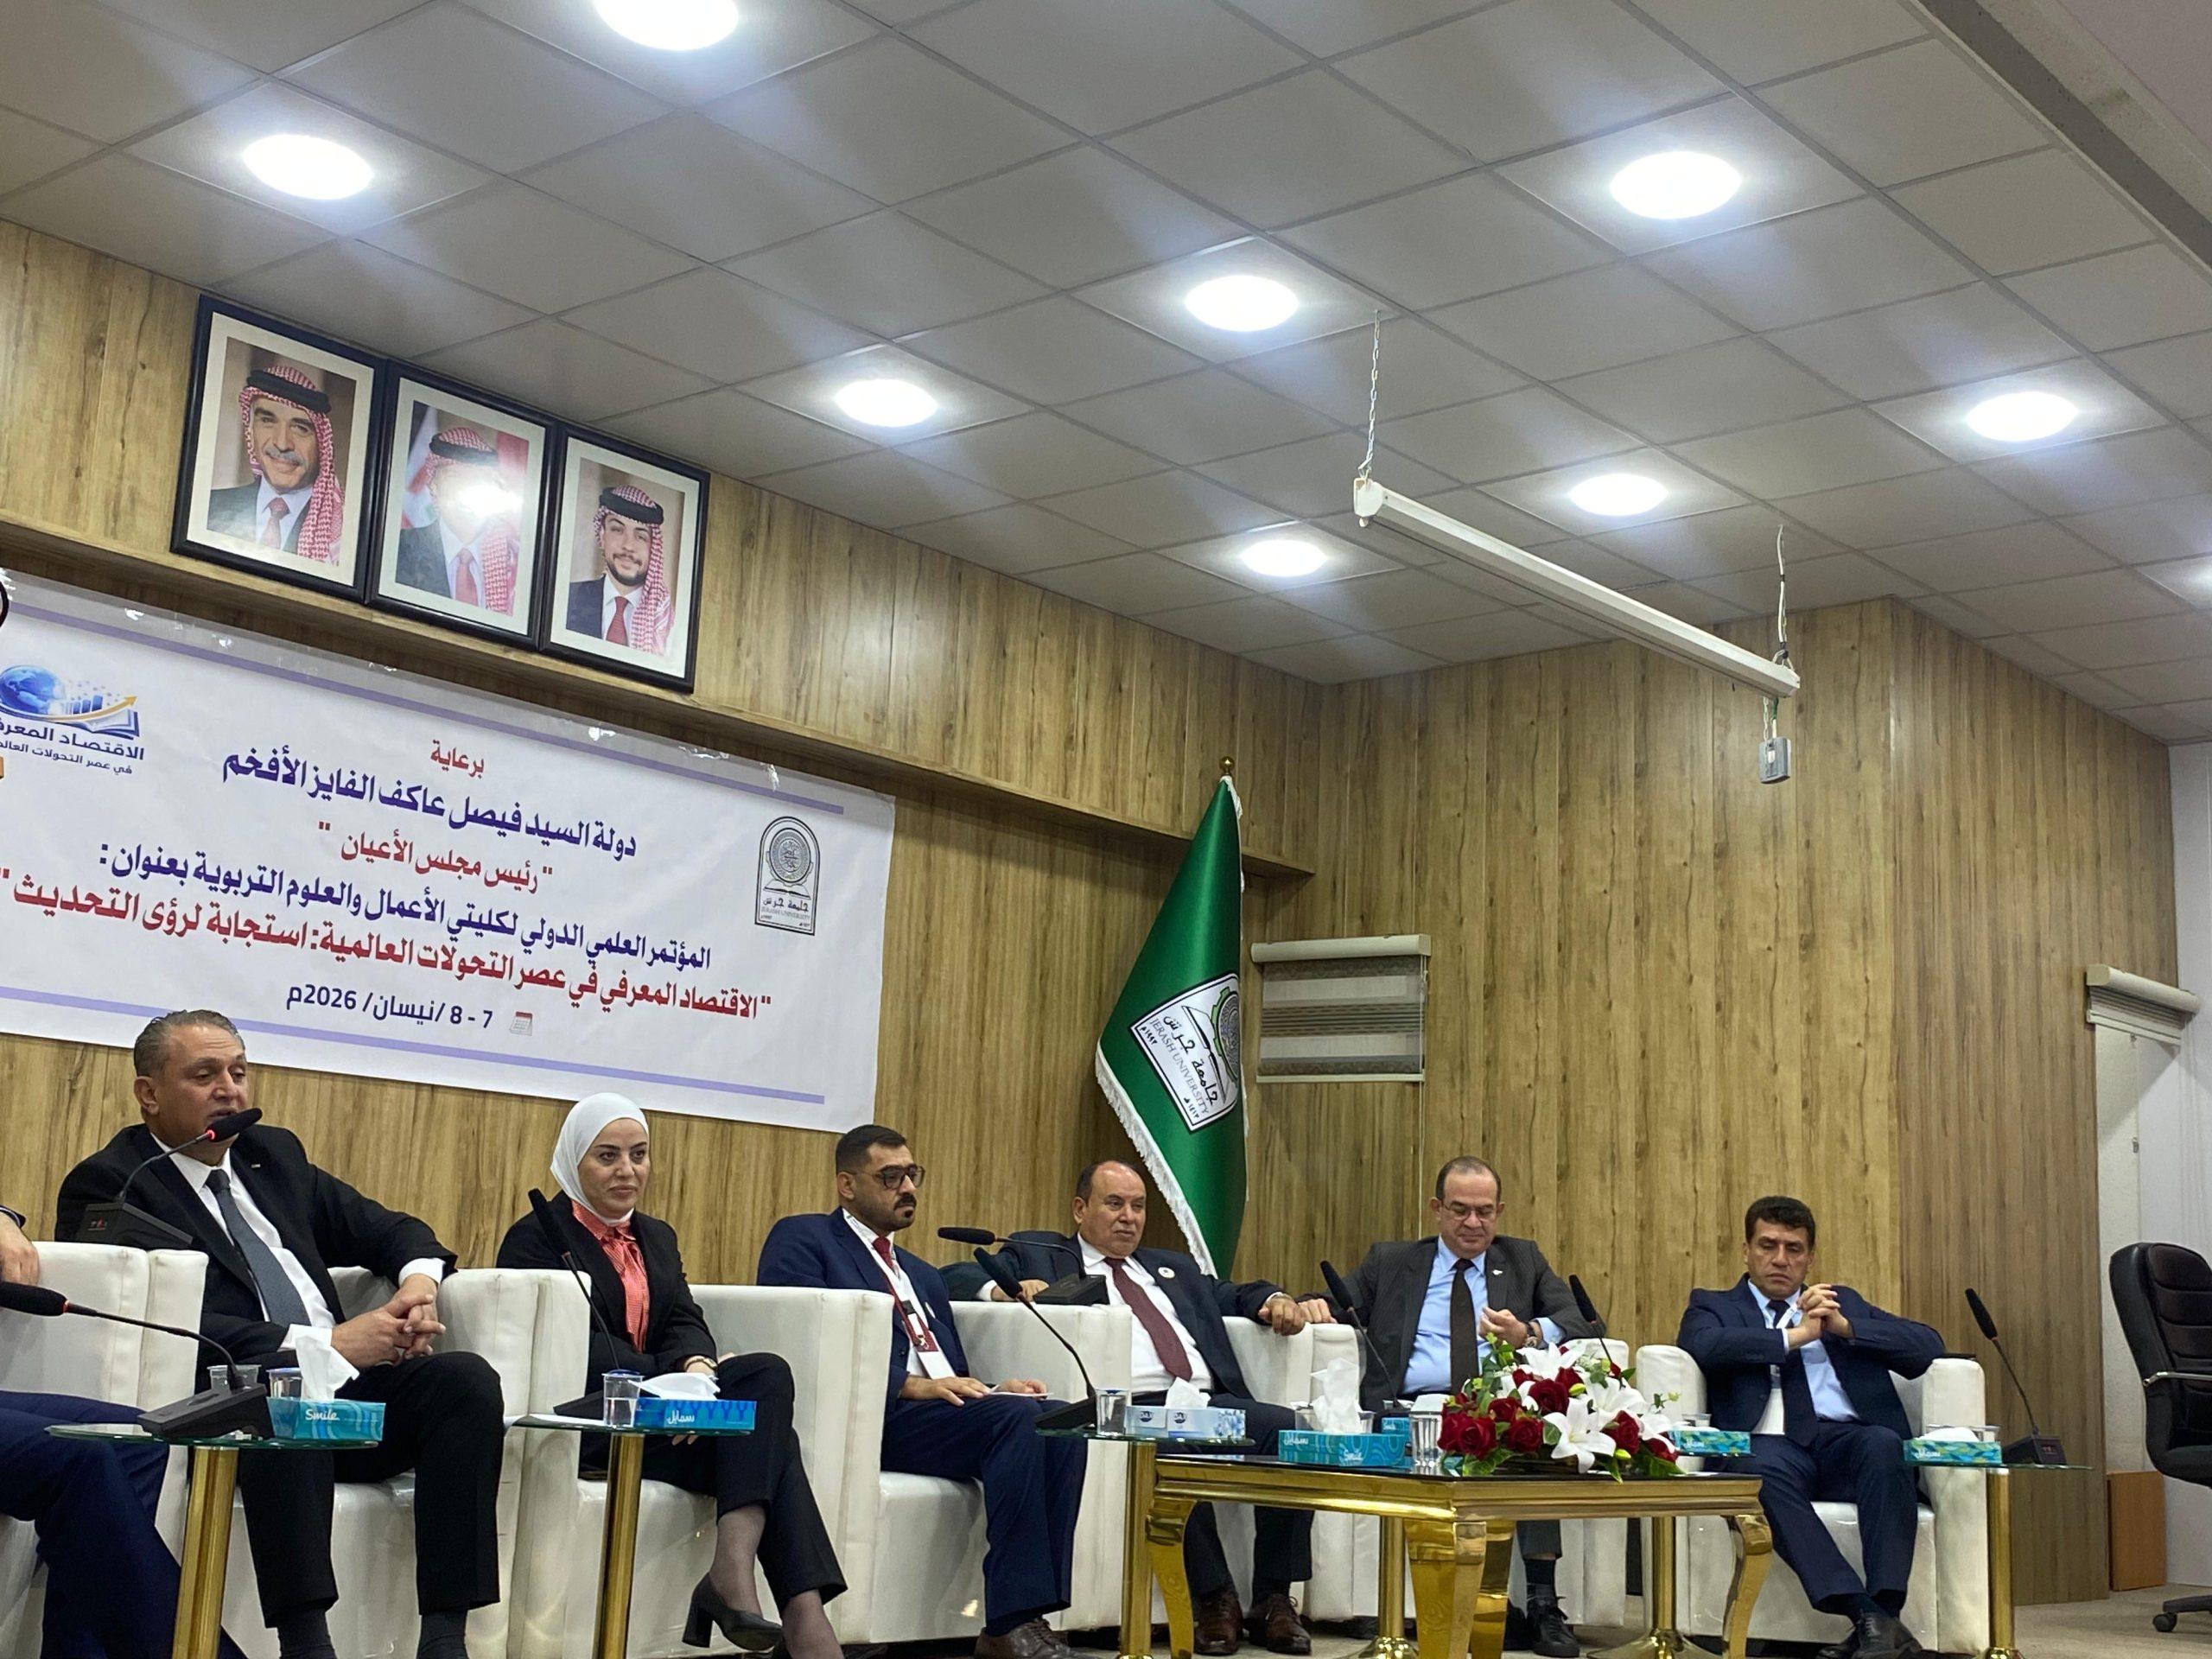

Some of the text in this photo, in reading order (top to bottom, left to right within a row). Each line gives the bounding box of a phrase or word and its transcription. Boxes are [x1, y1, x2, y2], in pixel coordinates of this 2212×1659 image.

[31, 747, 84, 765] التحولات
[59, 733, 145, 761] الاقتصاد
[86, 759, 111, 770] عصر
[430, 739, 485, 779] برعاية
[112, 764, 133, 776] في
[222, 744, 637, 862] دولة السيد فيصل عاكف الفايز الأفخم
[340, 828, 414, 864] الأعيان
[414, 849, 481, 880] مجلس
[192, 850, 284, 898] التربوية
[286, 876, 362, 917] والعلوم
[364, 886, 446, 925] الأعمال
[142, 897, 203, 938] لرؤى
[206, 900, 308, 949] استجابة
[446, 902, 519, 943] لكليتي
[520, 917, 584, 956] الدولي
[416, 944, 514, 982] التحولات
[585, 931, 646, 965] العلمي
[645, 939, 711, 973] المؤتمر
[513, 967, 566, 990] عصر
[569, 963, 598, 1009] في
[600, 969, 677, 1014] المعرفي
[449, 1005, 463, 1025] 8
[482, 1009, 493, 1029] 7
[1149, 1018, 1210, 1114] JERASH UNIVERSITY
[1192, 1058, 1217, 1107] جامعة
[305, 1408, 340, 1421] Smile
[666, 1409, 696, 1425] سمايل
